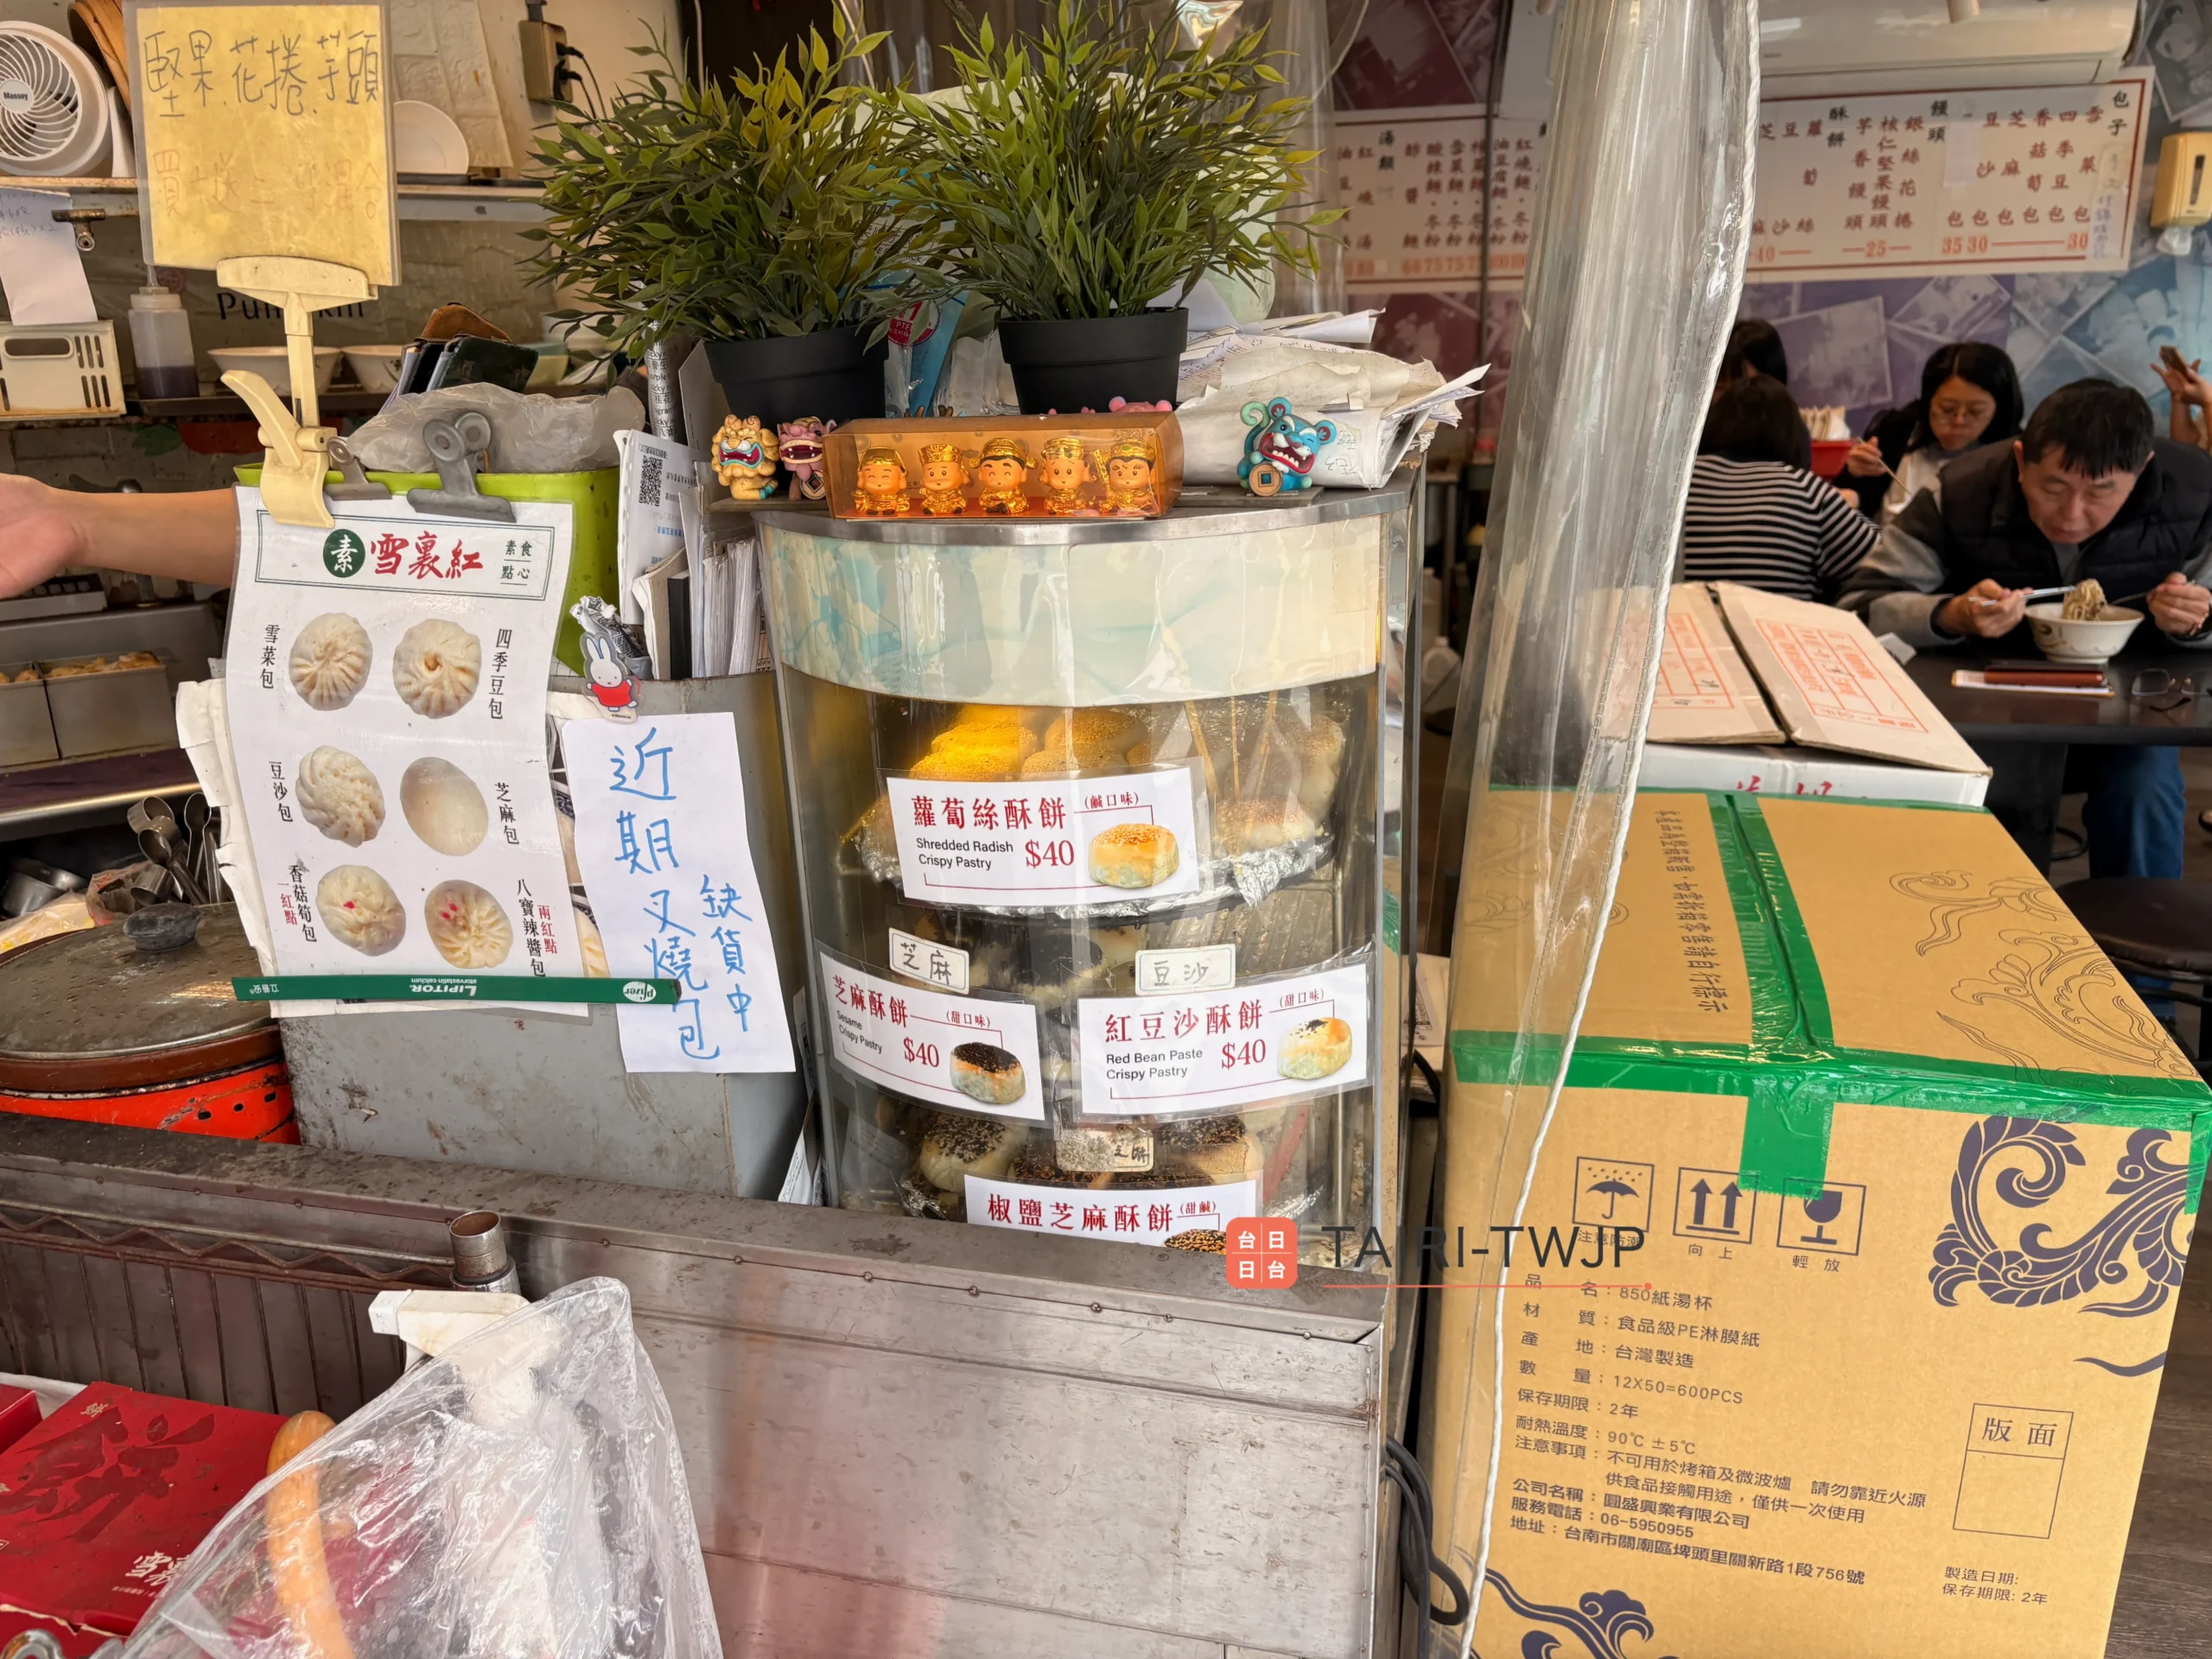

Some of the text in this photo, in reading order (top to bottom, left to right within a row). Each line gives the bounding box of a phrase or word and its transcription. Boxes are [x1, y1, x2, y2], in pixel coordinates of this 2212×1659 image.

[3, 92, 28, 101] Massey
[1927, 99, 1948, 143] 饅頭
[2107, 90, 2130, 137] 包子
[1973, 111, 2000, 227] 豆沙包
[1998, 109, 2027, 226] 芝麻包
[2049, 110, 2078, 224] 四季豆包
[1865, 240, 1887, 257] 25
[1942, 235, 1988, 255] 35 30
[2066, 232, 2088, 251] 30
[217, 292, 364, 321] Pumkin
[329, 533, 358, 573] 素
[370, 530, 484, 581] 雪裏紅
[505, 539, 533, 558] 素食
[500, 564, 531, 581] 點心
[259, 624, 281, 690] 雪菜包
[487, 628, 512, 721] 四季豆包
[268, 760, 293, 823] 豆沙包
[494, 781, 520, 845] 芝麻包
[911, 791, 1140, 830] 蘿蔔絲酥餅 (鹹口味)
[916, 837, 1014, 853] Shredded Radish
[1024, 839, 1075, 868] $40
[918, 854, 992, 871] Crispy Pastry
[277, 883, 298, 925] 一紅點
[288, 864, 317, 944] 香菇筍包
[517, 879, 546, 977] 八寶辣醬包
[537, 905, 558, 955] 兩紅點
[699, 874, 753, 1032] 缺貨中
[901, 942, 952, 985] 芝麻
[1154, 960, 1210, 987] 豆沙
[832, 975, 992, 1028] 芝麻酥餅 (甜口味)
[1104, 988, 1325, 1044] 紅豆沙酥餅 (甜口味)
[836, 1010, 863, 1031] Sesame
[838, 1024, 883, 1054] Crispy Pastry
[903, 1036, 940, 1069] $40
[1221, 1039, 1267, 1071] $40
[1106, 1048, 1204, 1065] Red Bean Paste
[1106, 1066, 1188, 1081] Crispy Pastry
[987, 1192, 1218, 1233] 椒鹽芝麻酥餅 (甜鹹)
[1688, 1243, 1734, 1261] 向上
[1791, 1254, 1840, 1273] 輕放
[1981, 1417, 2058, 1446] 版面
[1811, 1479, 1927, 1509] 請勿靠近火源
[1944, 1566, 2019, 1586] 製造日期:
